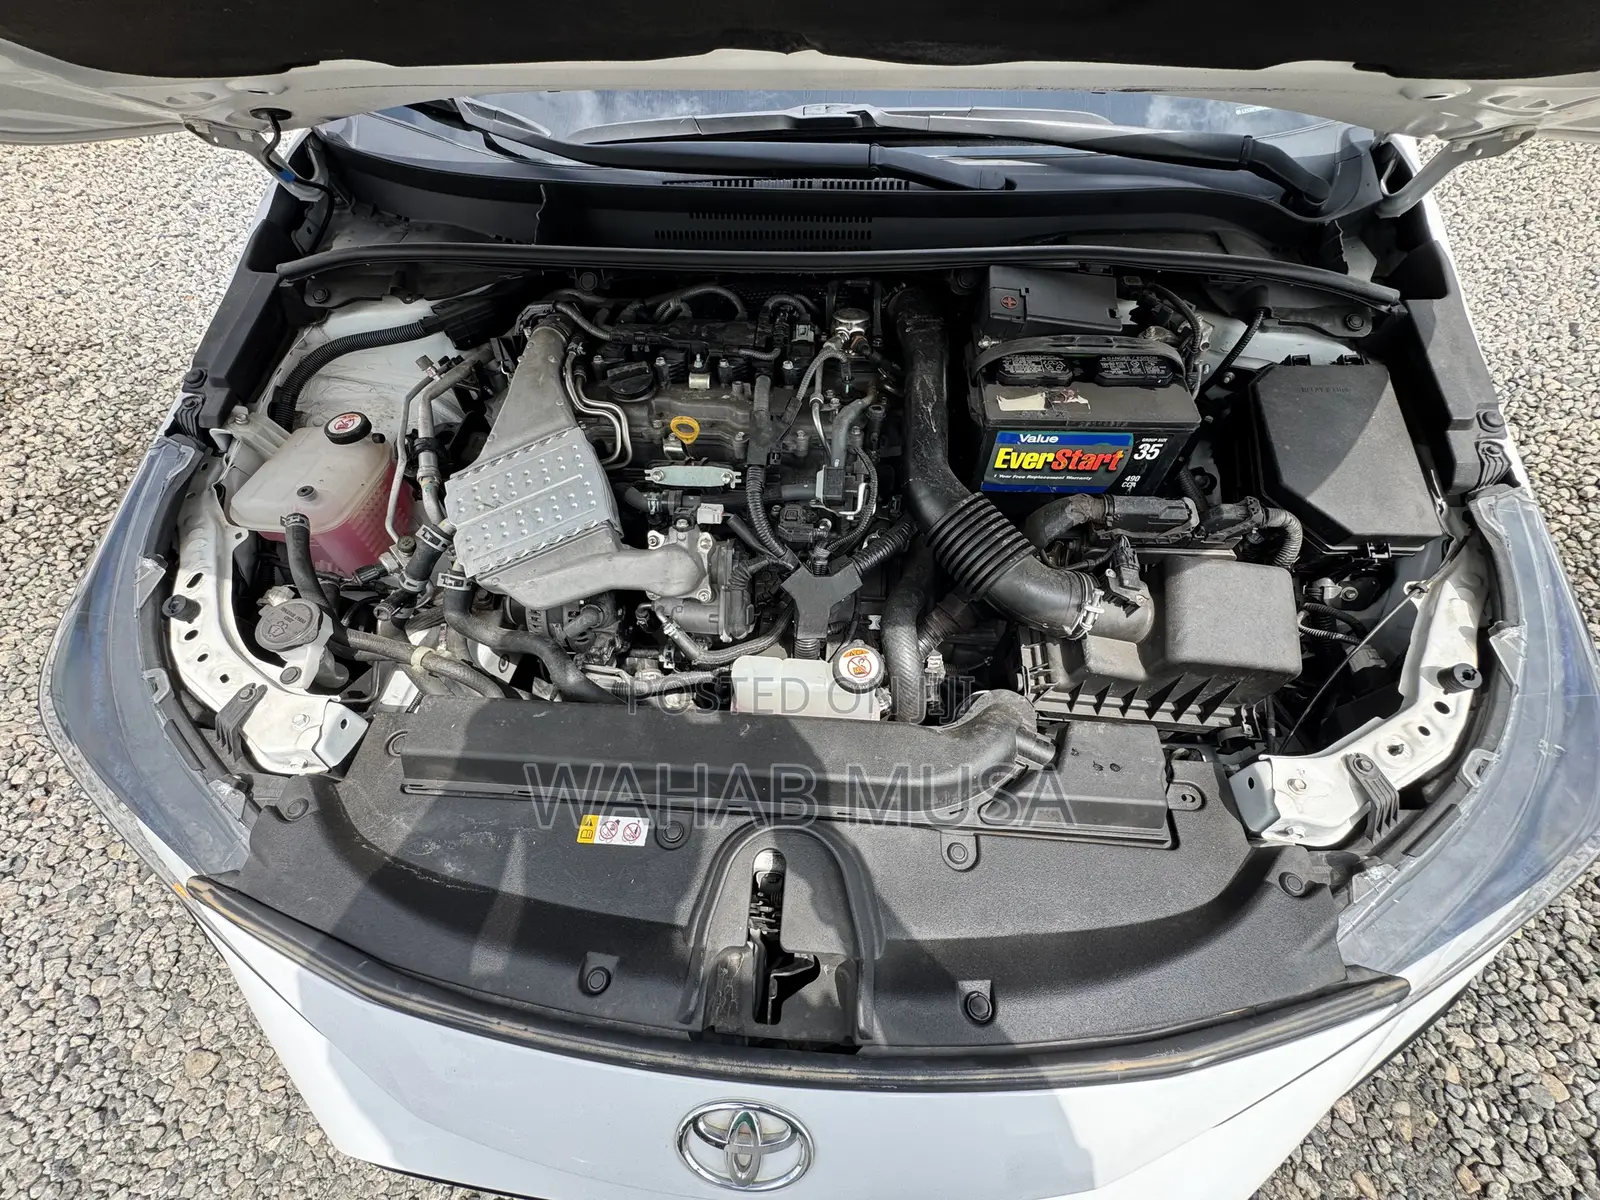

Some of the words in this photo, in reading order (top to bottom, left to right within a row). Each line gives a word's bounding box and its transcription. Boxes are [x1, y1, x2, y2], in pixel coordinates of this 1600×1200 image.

[1019, 434, 1059, 443] Value
[994, 447, 1124, 471] EverStart
[1133, 443, 1164, 460] 35
